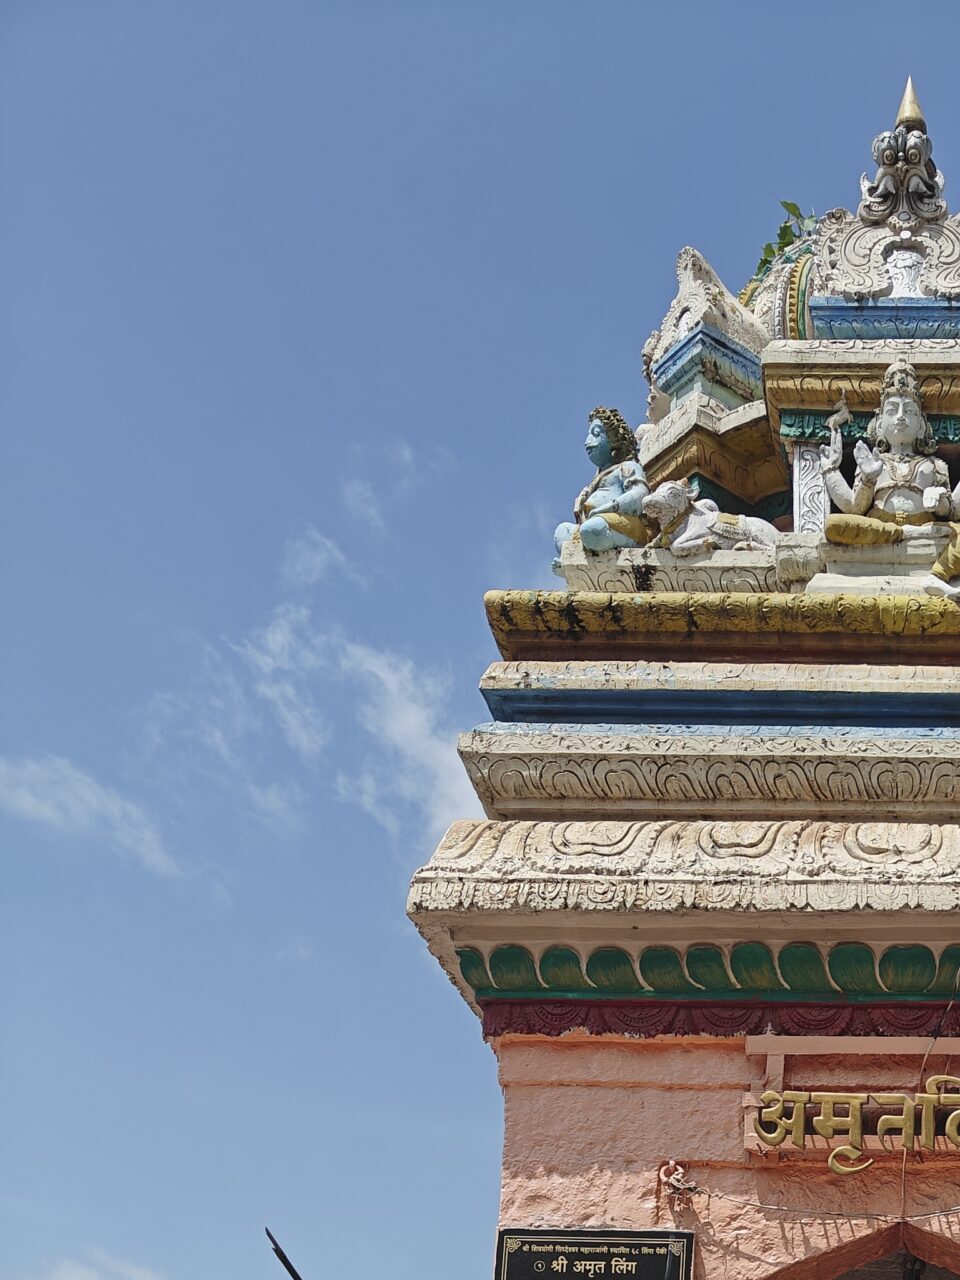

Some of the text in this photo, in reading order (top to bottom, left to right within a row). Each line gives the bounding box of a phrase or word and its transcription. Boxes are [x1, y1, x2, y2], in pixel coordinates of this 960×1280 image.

[551, 1255, 568, 1273] श्री
[572, 1260, 606, 1278] अमृत
[610, 1258, 638, 1275] लिंग
